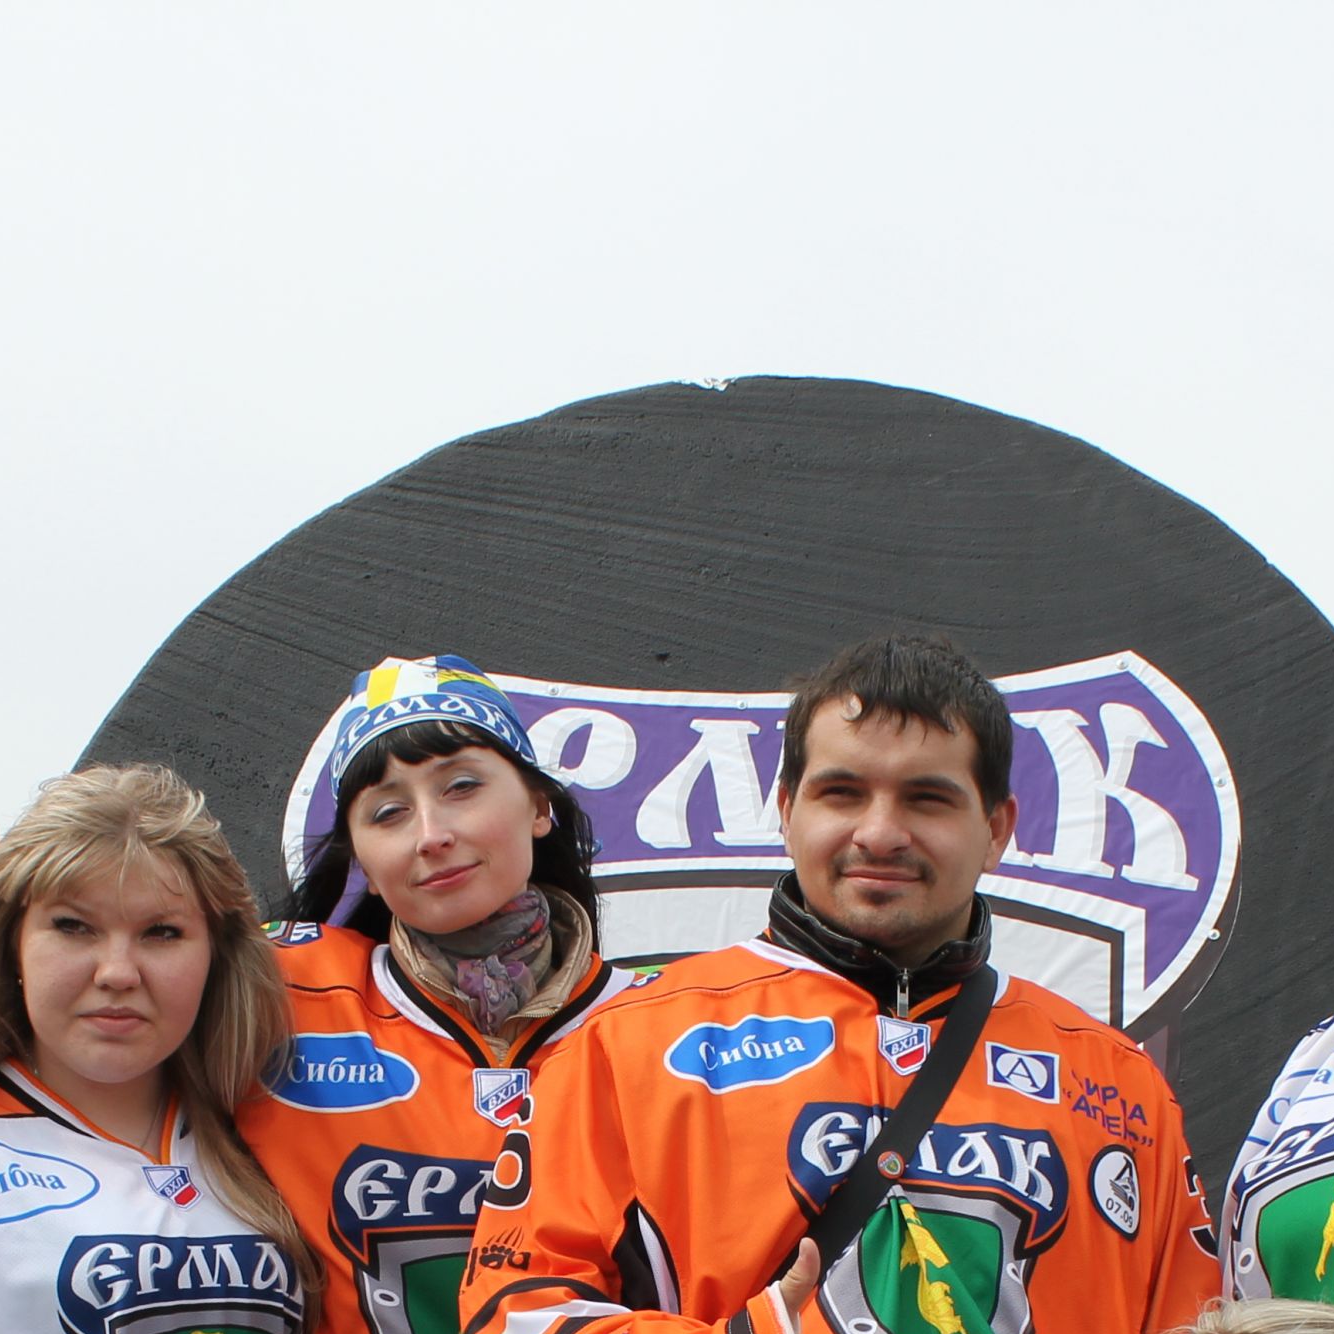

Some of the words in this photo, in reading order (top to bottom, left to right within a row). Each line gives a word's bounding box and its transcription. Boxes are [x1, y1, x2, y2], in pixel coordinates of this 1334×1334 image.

[528, 702, 1198, 891] РМК
[698, 1032, 807, 1071] Сибна
[890, 1033, 919, 1056] ВХЛ
[288, 1055, 385, 1085] Сибна
[487, 1082, 518, 1110] ВХЛ
[800, 1111, 1054, 1212] ЕАК
[164, 1175, 185, 1197] ВХЛ
[70, 1241, 297, 1310] ЕРМА
